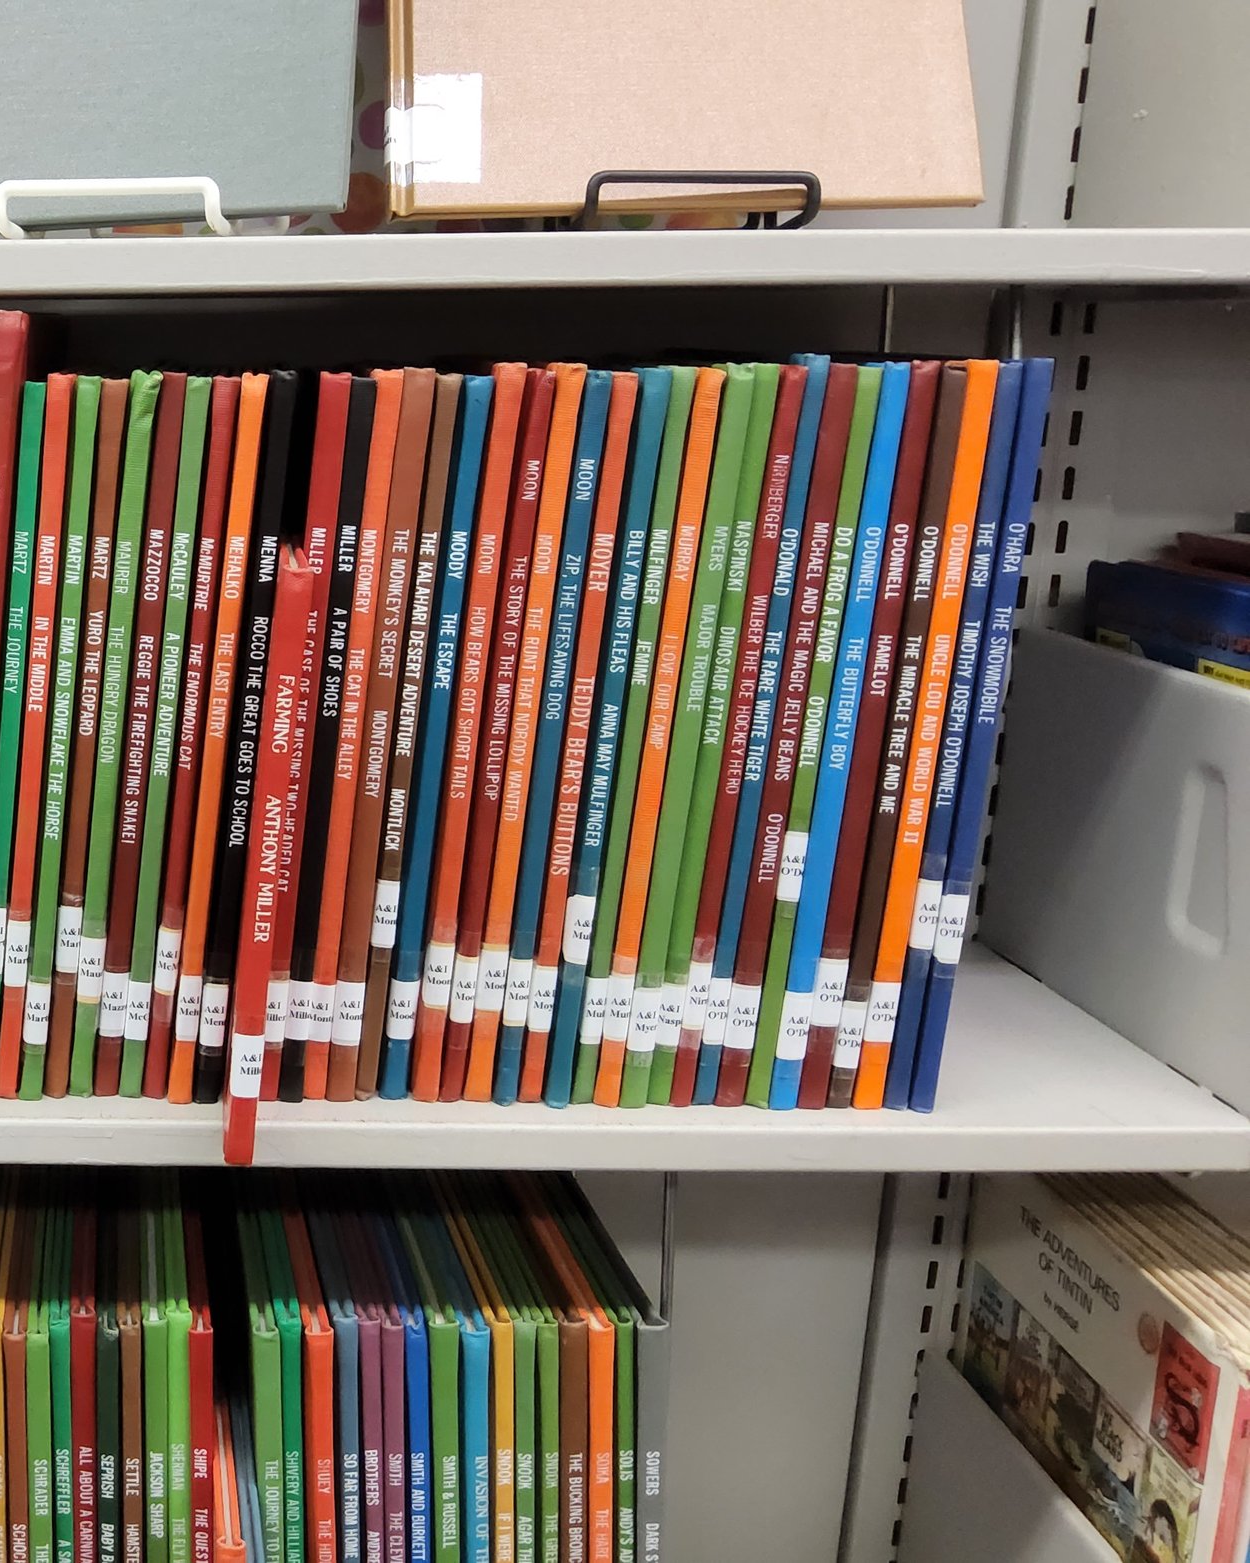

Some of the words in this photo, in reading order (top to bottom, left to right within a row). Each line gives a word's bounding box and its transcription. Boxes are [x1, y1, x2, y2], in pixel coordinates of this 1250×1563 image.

[12, 530, 29, 574] MARTZ
[91, 536, 110, 578] MARTZ
[445, 530, 465, 580] MOODY
[726, 520, 752, 592] NASPINSKI
[975, 522, 994, 546] THE
[1001, 524, 1024, 572] O'HARA
[37, 536, 55, 586] MARTIN
[169, 532, 189, 600] McCAULEY
[588, 532, 612, 592] MOYER
[642, 530, 667, 606] MULFINGER
[883, 524, 909, 600] O'DONNELL
[969, 554, 989, 588] WISH
[8, 606, 24, 630] THE
[86, 610, 103, 644] YURO
[439, 612, 457, 638] THE
[992, 606, 1011, 630] THE
[4, 636, 22, 694] JOURNEY
[32, 636, 48, 658] THE
[84, 652, 100, 672] THE
[434, 642, 454, 690] ESCAPE
[631, 638, 652, 686] JEMIME
[711, 626, 736, 690] DINOSAUR
[870, 636, 893, 696] HAMELOT
[955, 620, 979, 678] TIMOTHY
[28, 664, 46, 712] MIDDLE
[160, 646, 179, 700] PIONEER
[977, 638, 1006, 724] SNOWMOBILE
[78, 680, 98, 736] LEOPARD
[272, 674, 296, 754] FARMING
[570, 676, 594, 730] TEDDY
[703, 696, 725, 744] ATTACK
[947, 682, 970, 732] JOSEPH
[153, 704, 174, 776] ADVENTURE
[561, 738, 586, 794] BEAR'S
[935, 738, 961, 808] O'DONNELL
[260, 794, 284, 876] ANTHONY
[550, 802, 577, 876] BUTTONS
[254, 882, 276, 942] MILLER
[1038, 1252, 1054, 1273] OF
[1057, 1267, 1093, 1315] TINTIN
[1042, 1230, 1120, 1312] ADVENTURES
[150, 1450, 164, 1498] JACKSON
[194, 1448, 208, 1478] SHIPE
[344, 1472, 357, 1490] FAR
[412, 1452, 425, 1484] SMITH
[442, 1456, 456, 1488] SMITH
[620, 1450, 633, 1480] SOLIS
[646, 1450, 660, 1496] SOWERS
[150, 1502, 164, 1538] SHARP
[344, 1496, 358, 1526] FROM
[412, 1488, 425, 1510] AND
[345, 1530, 358, 1558] HOME
[412, 1514, 426, 1560] BURKETT
[443, 1502, 456, 1548] RUSSELL
